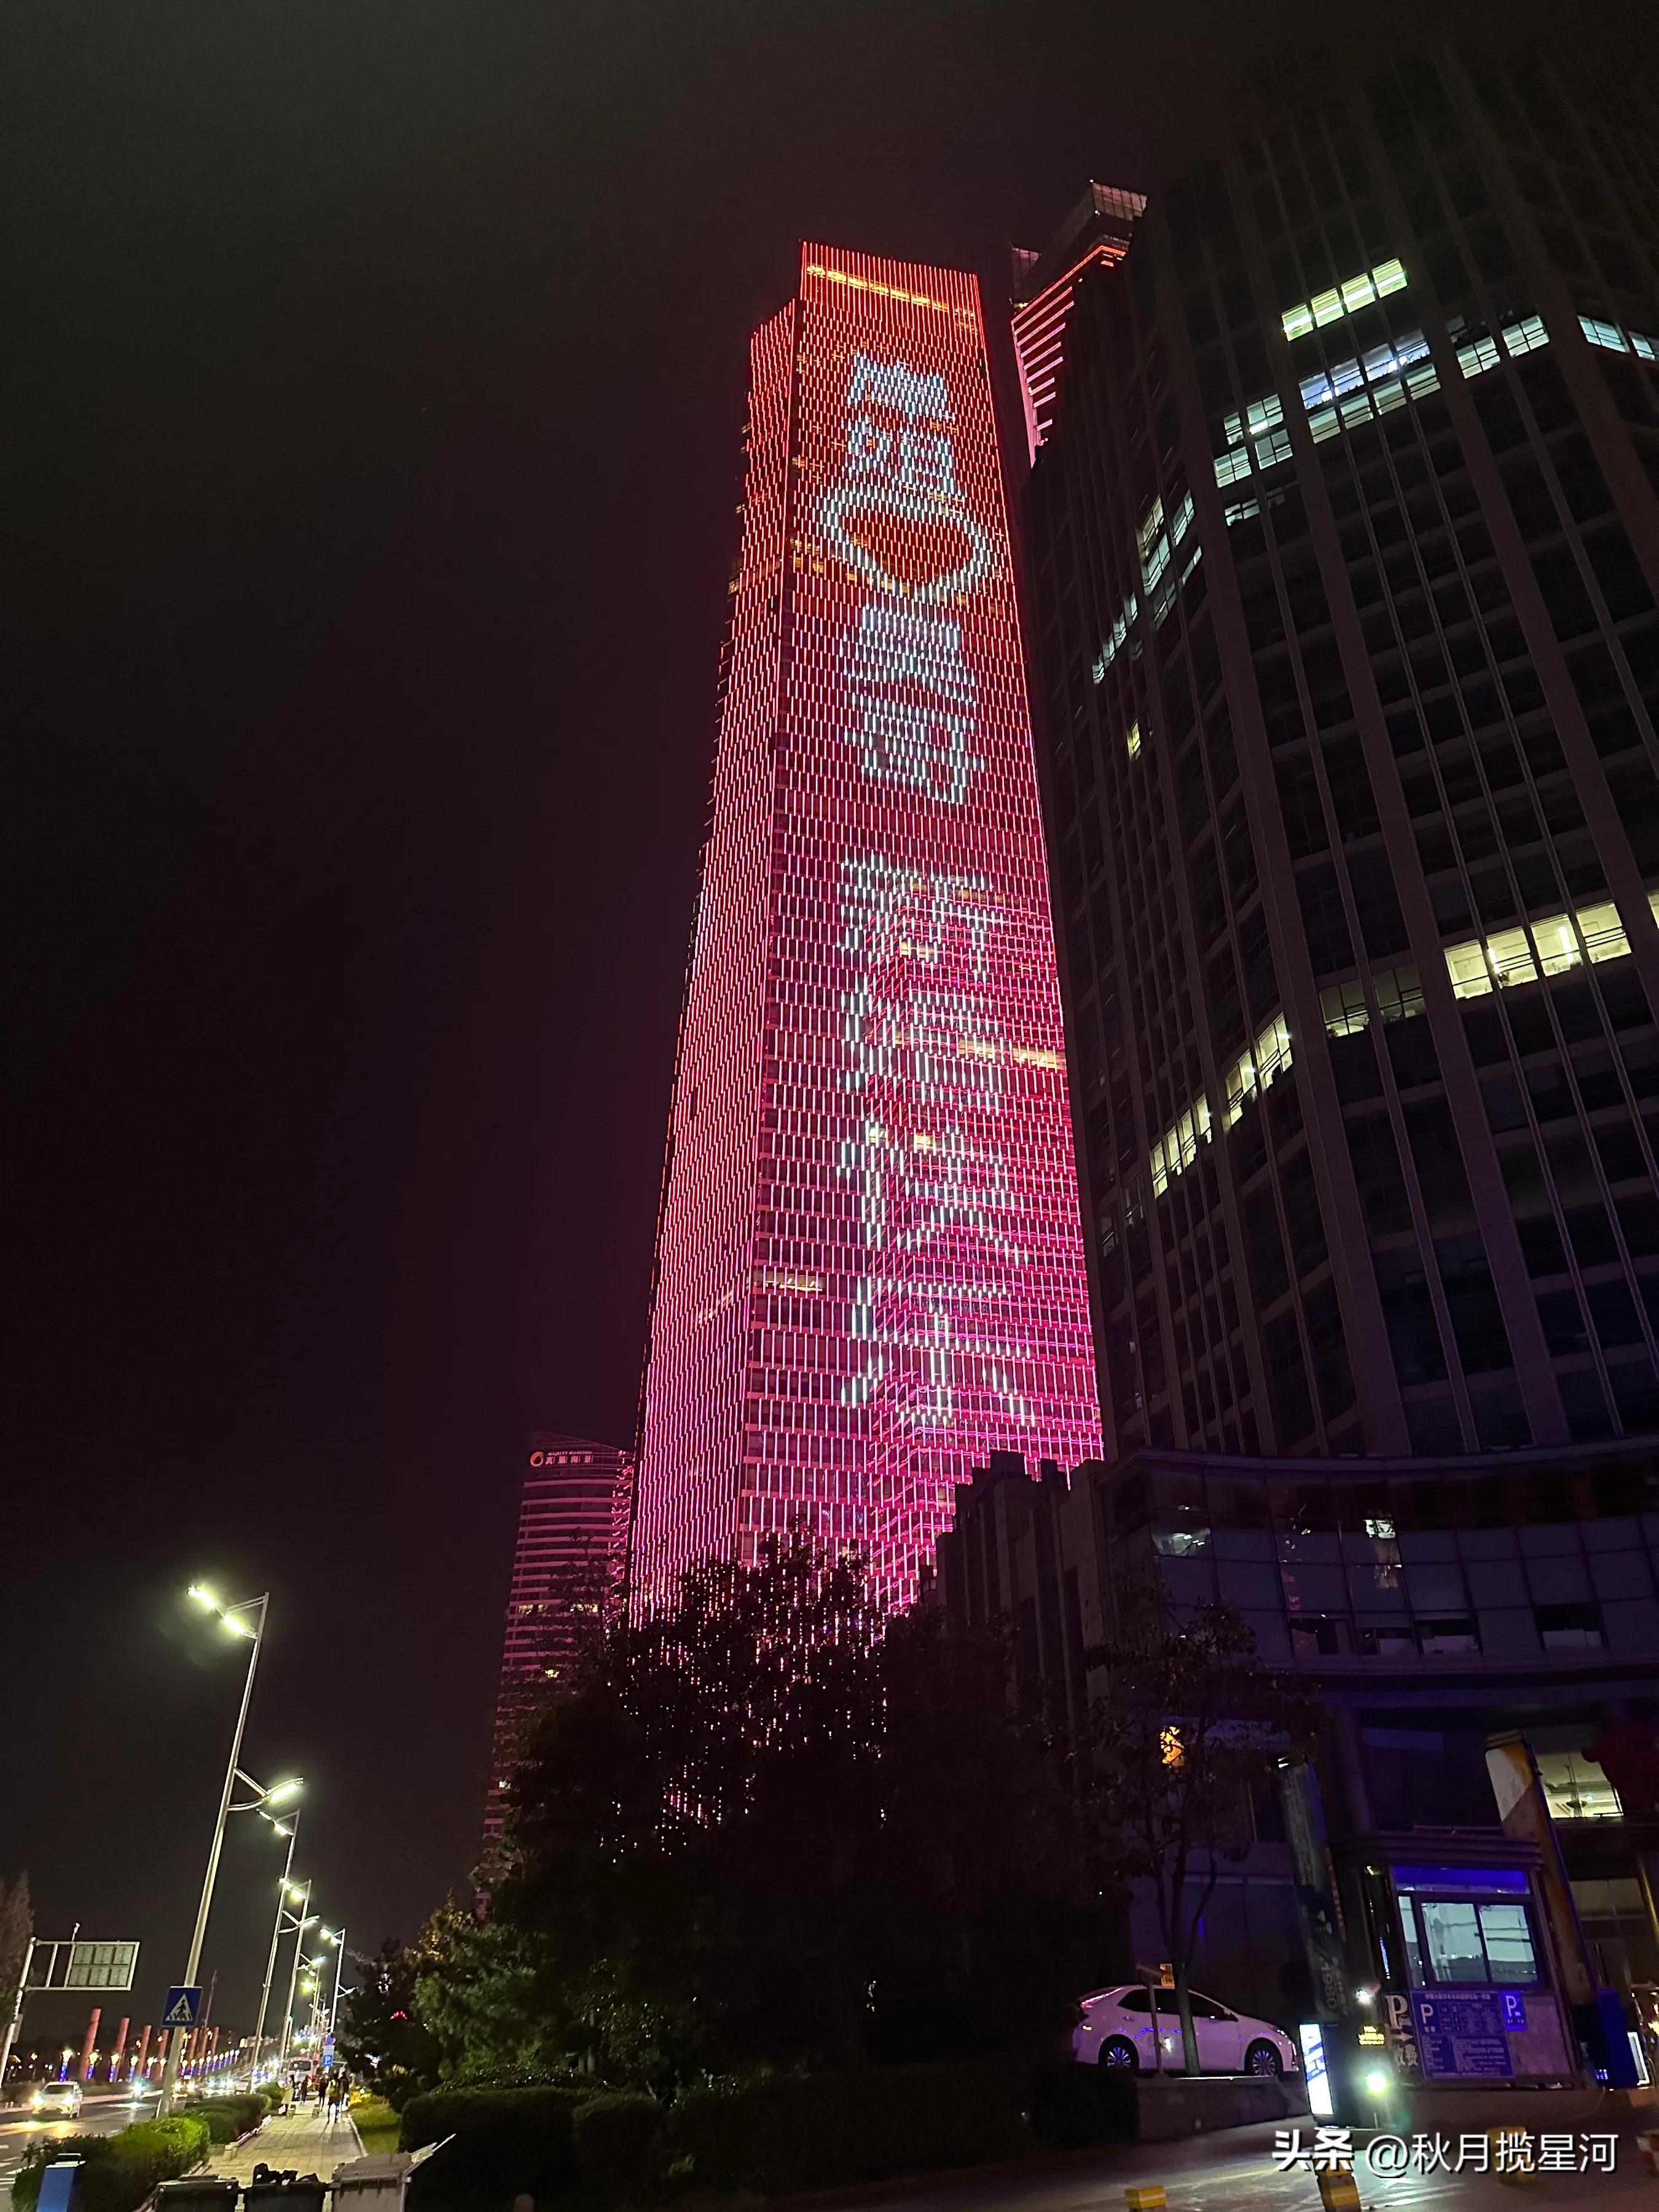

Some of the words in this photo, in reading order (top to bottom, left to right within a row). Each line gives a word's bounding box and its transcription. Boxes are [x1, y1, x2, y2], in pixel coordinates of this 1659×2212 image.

[837, 850, 1035, 1427] 新婚快乐
[1384, 1994, 1408, 2029] P
[1420, 2004, 1434, 2024] P
[1505, 1995, 1517, 2017] P
[324, 2056, 331, 2065] P
